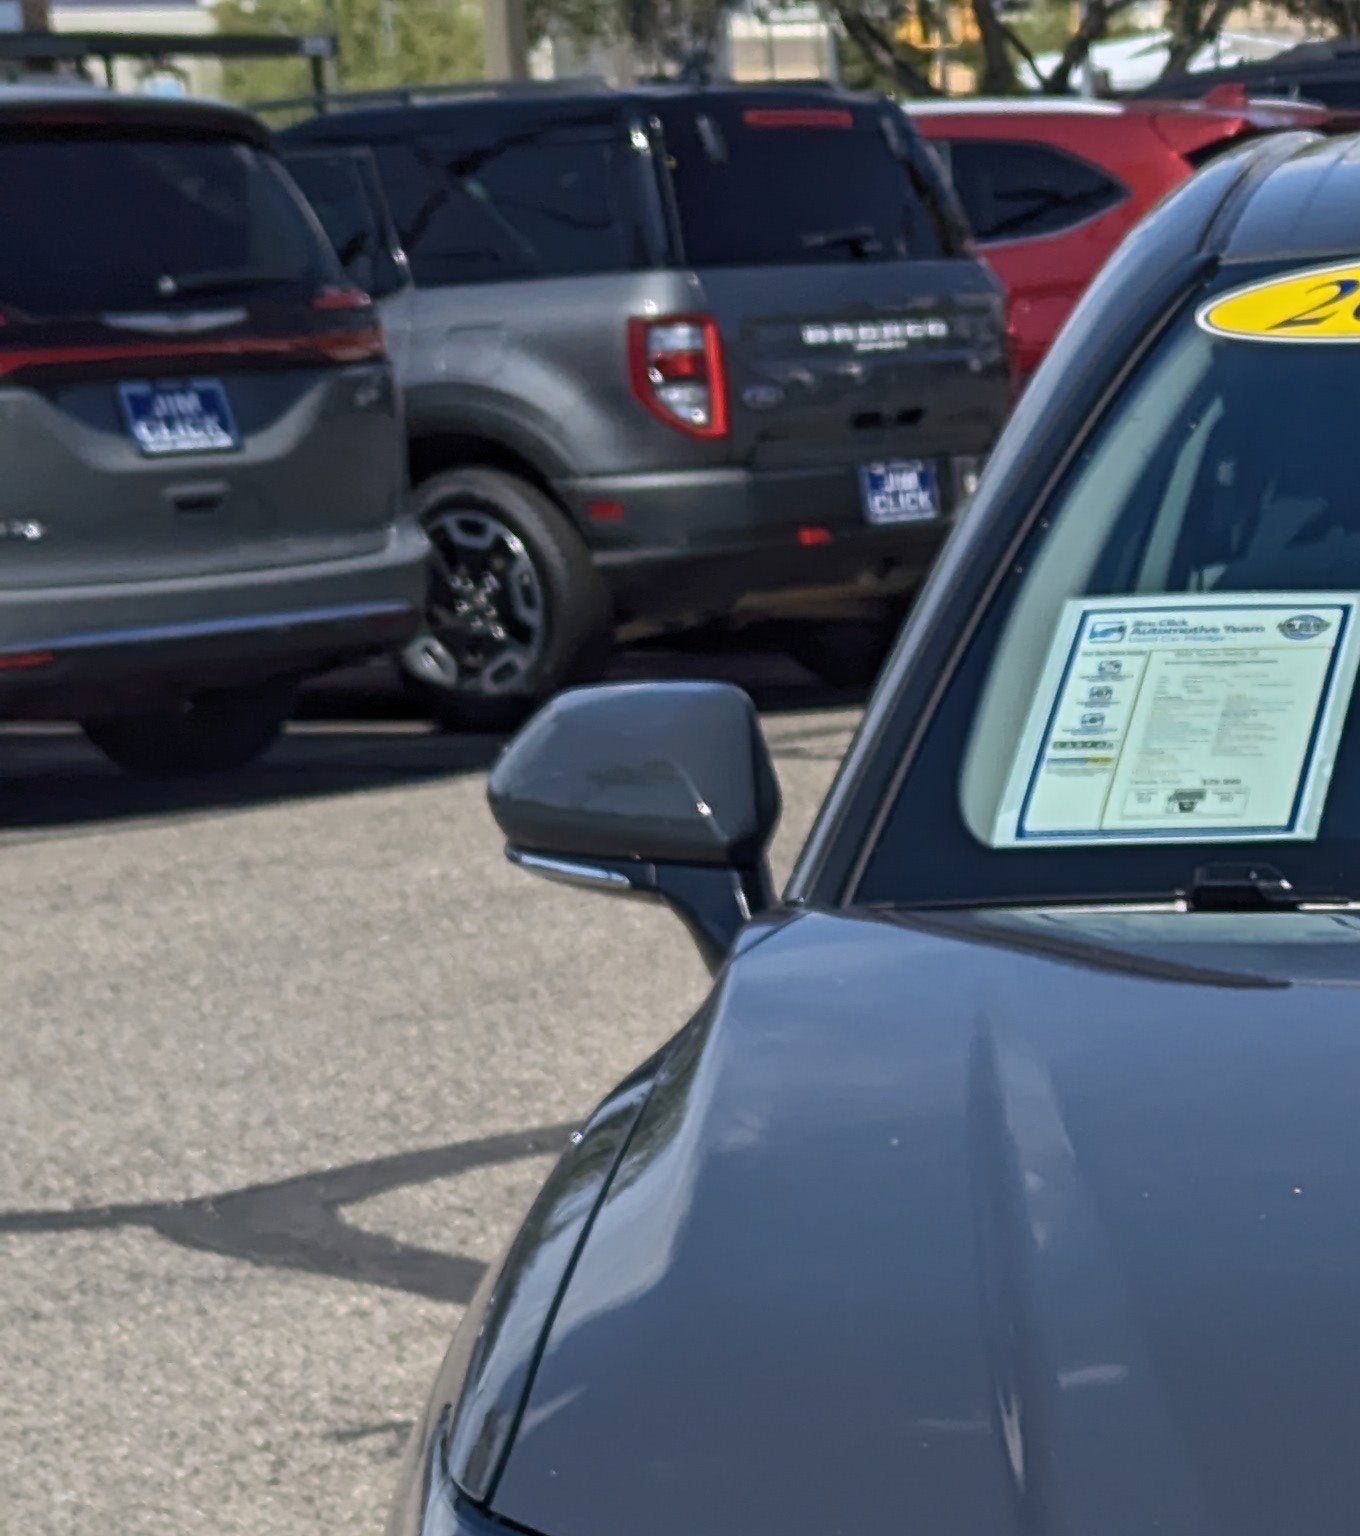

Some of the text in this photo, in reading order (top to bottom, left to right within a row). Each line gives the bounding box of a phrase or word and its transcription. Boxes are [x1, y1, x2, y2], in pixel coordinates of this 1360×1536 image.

[1158, 617, 1189, 626] Click
[1130, 624, 1266, 635] Automotive Team
